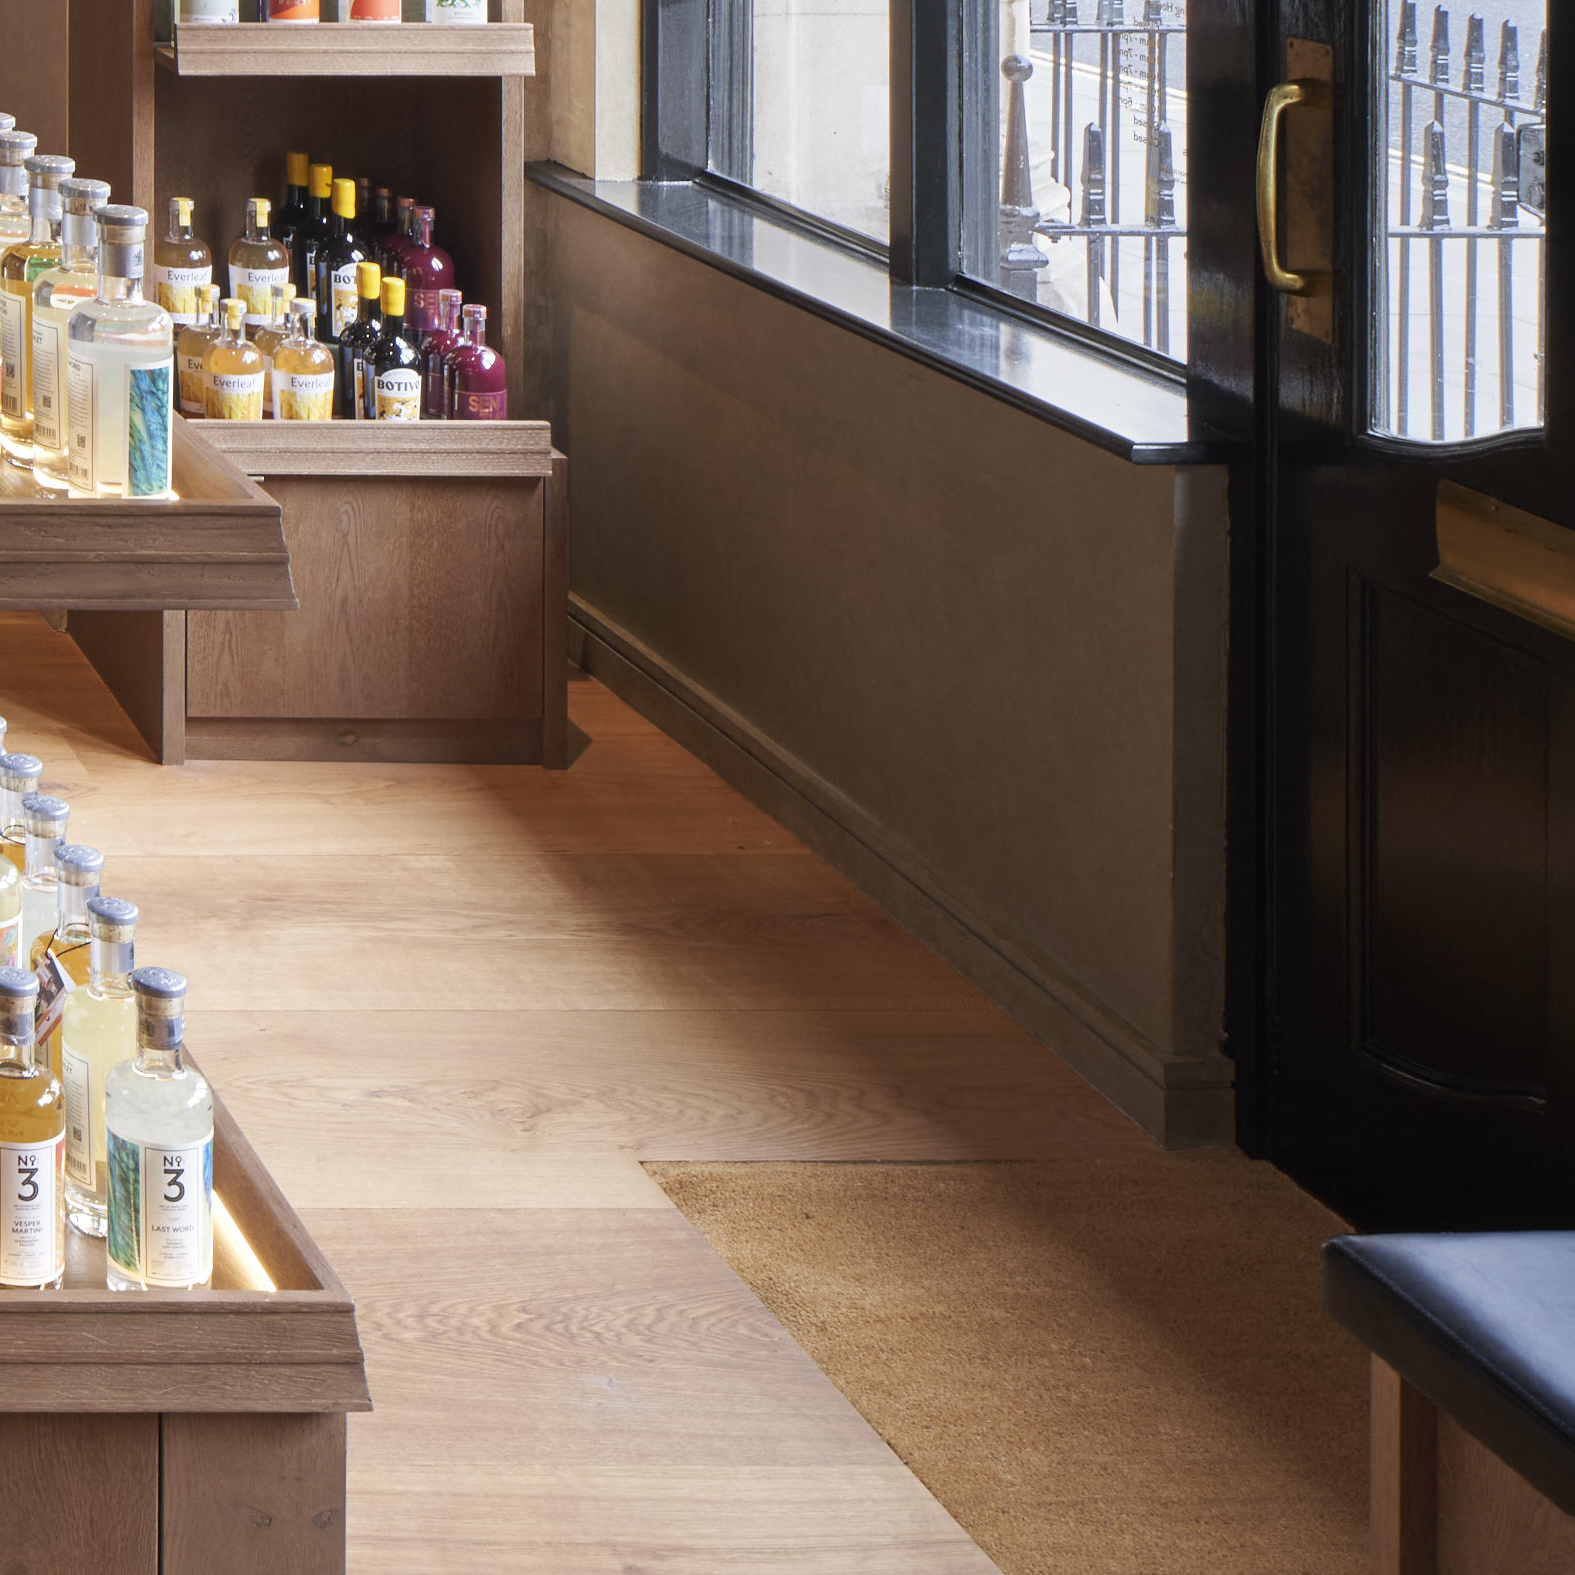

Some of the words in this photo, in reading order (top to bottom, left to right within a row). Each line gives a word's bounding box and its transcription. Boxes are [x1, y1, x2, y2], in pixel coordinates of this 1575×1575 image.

[18, 1168, 39, 1202] 3
[163, 1169, 185, 1202] 3
[12, 1227, 43, 1235] MARTINI
[152, 1225, 173, 1233] LAST
